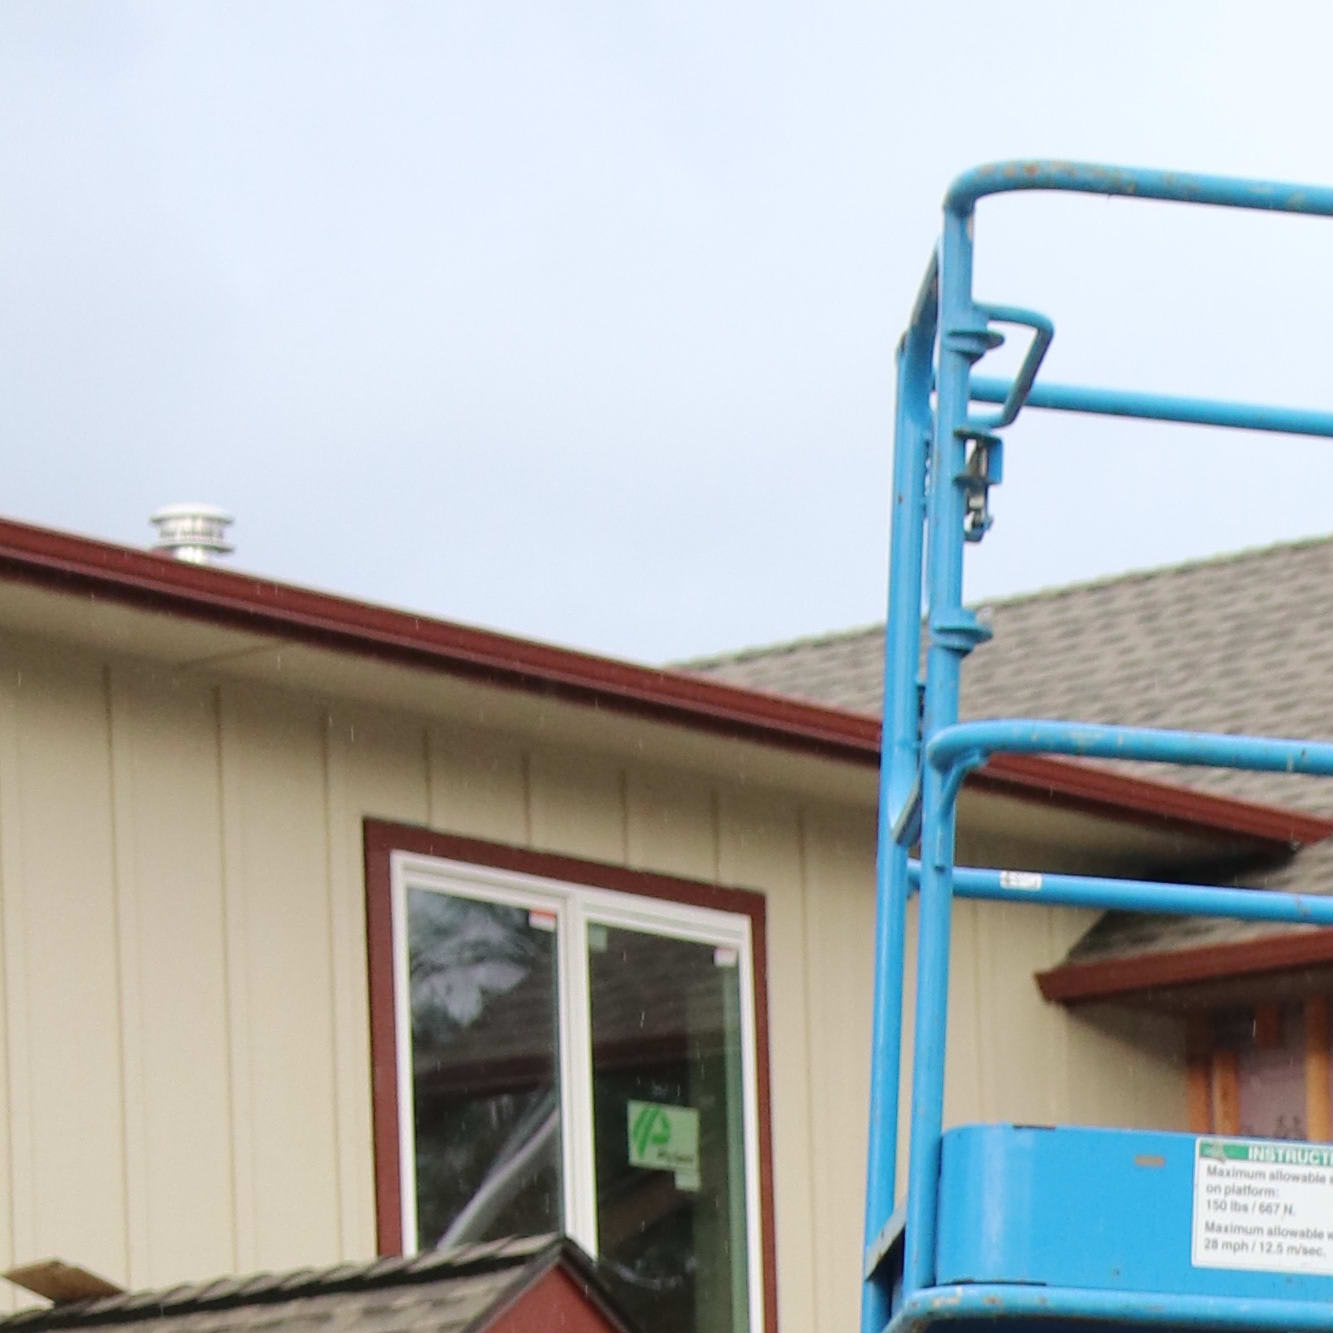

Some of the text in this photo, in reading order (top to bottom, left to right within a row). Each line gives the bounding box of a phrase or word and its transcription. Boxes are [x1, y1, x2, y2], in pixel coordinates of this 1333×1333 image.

[1206, 1165, 1266, 1181] Maximum
[1268, 1169, 1327, 1185] allowable
[1206, 1182, 1279, 1199] on platform:
[1206, 1200, 1227, 1212] 150
[1230, 1201, 1249, 1213] lbs
[1258, 1202, 1279, 1214] 667
[1204, 1221, 1264, 1236] Maximum
[1266, 1224, 1325, 1240] allowable
[1204, 1239, 1218, 1250] 28
[1221, 1240, 1249, 1253] mph
[1260, 1242, 1283, 1255] 12.5
